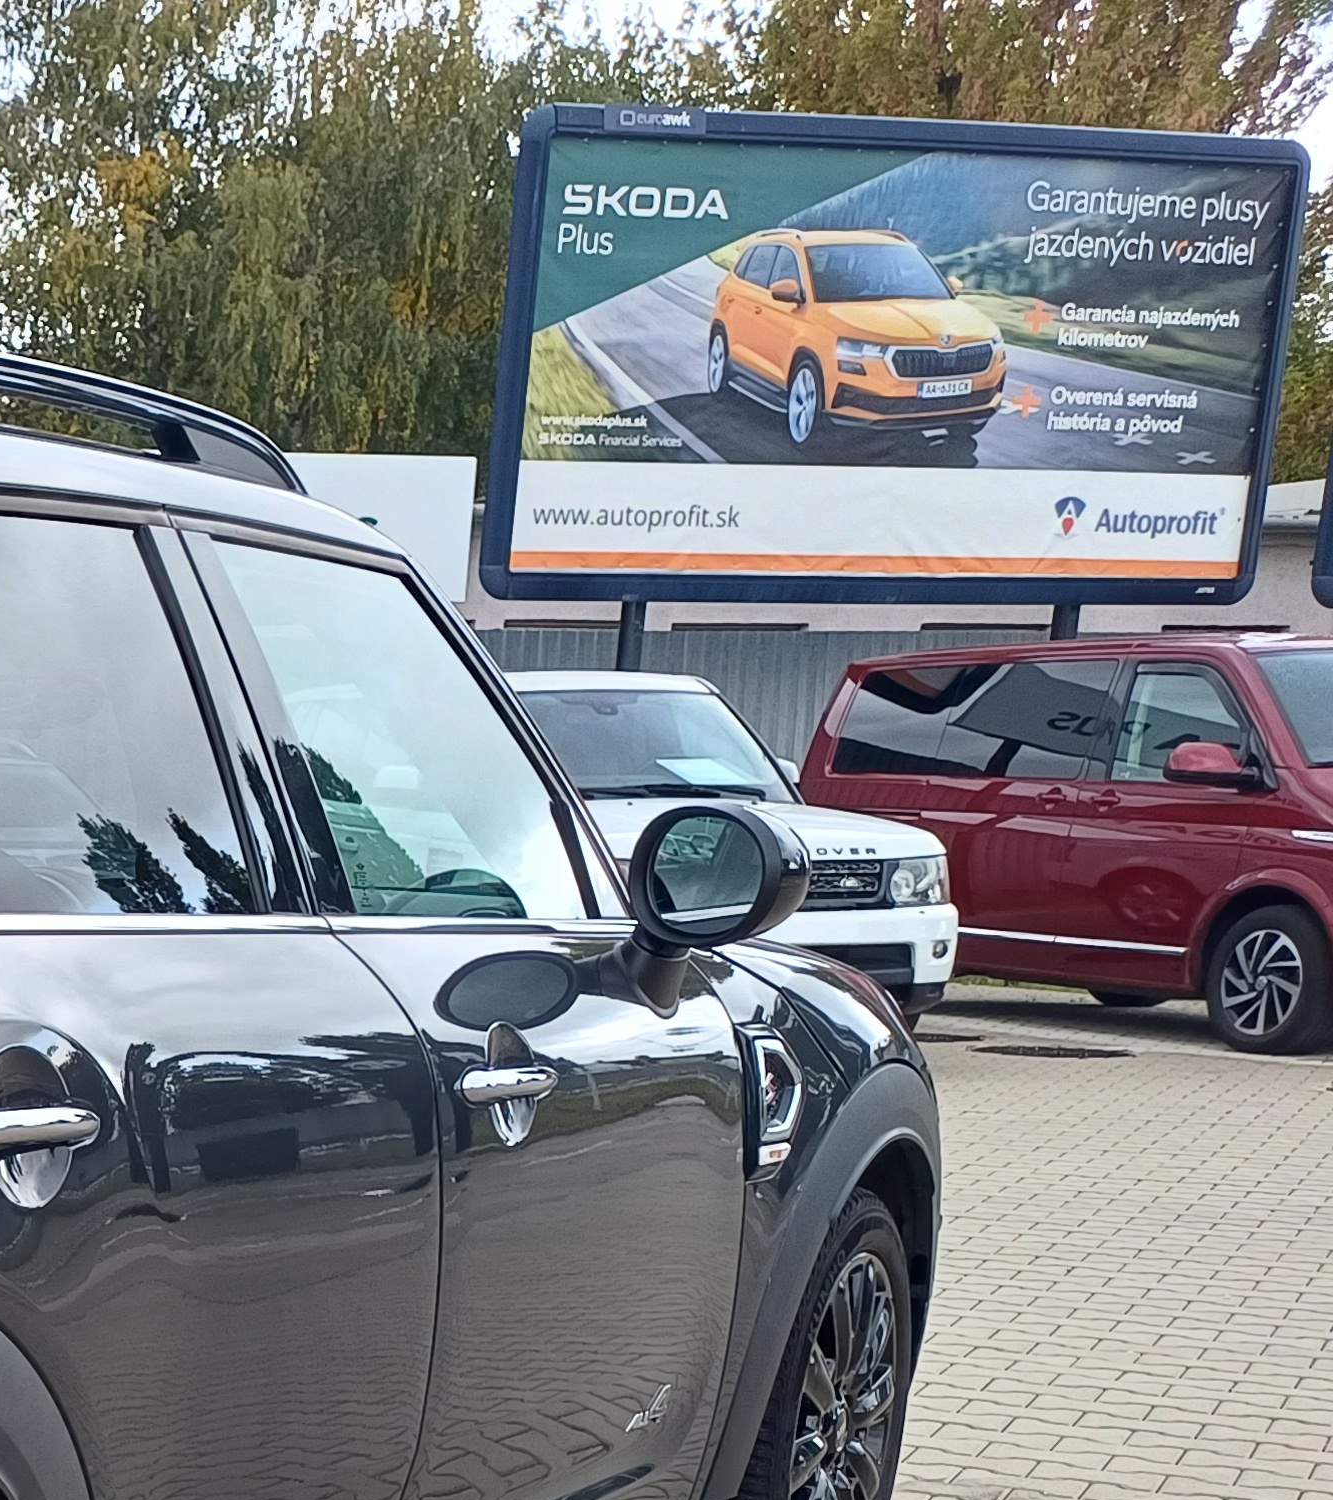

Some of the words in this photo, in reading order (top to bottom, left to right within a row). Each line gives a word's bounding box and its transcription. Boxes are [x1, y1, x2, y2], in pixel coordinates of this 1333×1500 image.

[1026, 180, 1197, 224] Garantujeme
[1201, 191, 1272, 230] plusy
[557, 222, 614, 256] Plus
[1023, 226, 1154, 267] jazdených
[1160, 234, 1257, 266] vozidiel
[1060, 302, 1136, 324] Garancia
[1139, 305, 1240, 331] najazdených
[1057, 327, 1149, 349] kilometrov
[1050, 385, 1124, 406] Overená
[1126, 389, 1199, 409] servisná
[1046, 410, 1111, 432] história
[1114, 417, 1125, 432] a
[1128, 413, 1184, 437] pôvod
[599, 433, 640, 447] Financial
[641, 434, 683, 448] Services
[532, 504, 741, 533] www.autoprofit.sk
[1094, 507, 1218, 540] Autoprofit
[815, 847, 877, 857] OVER
